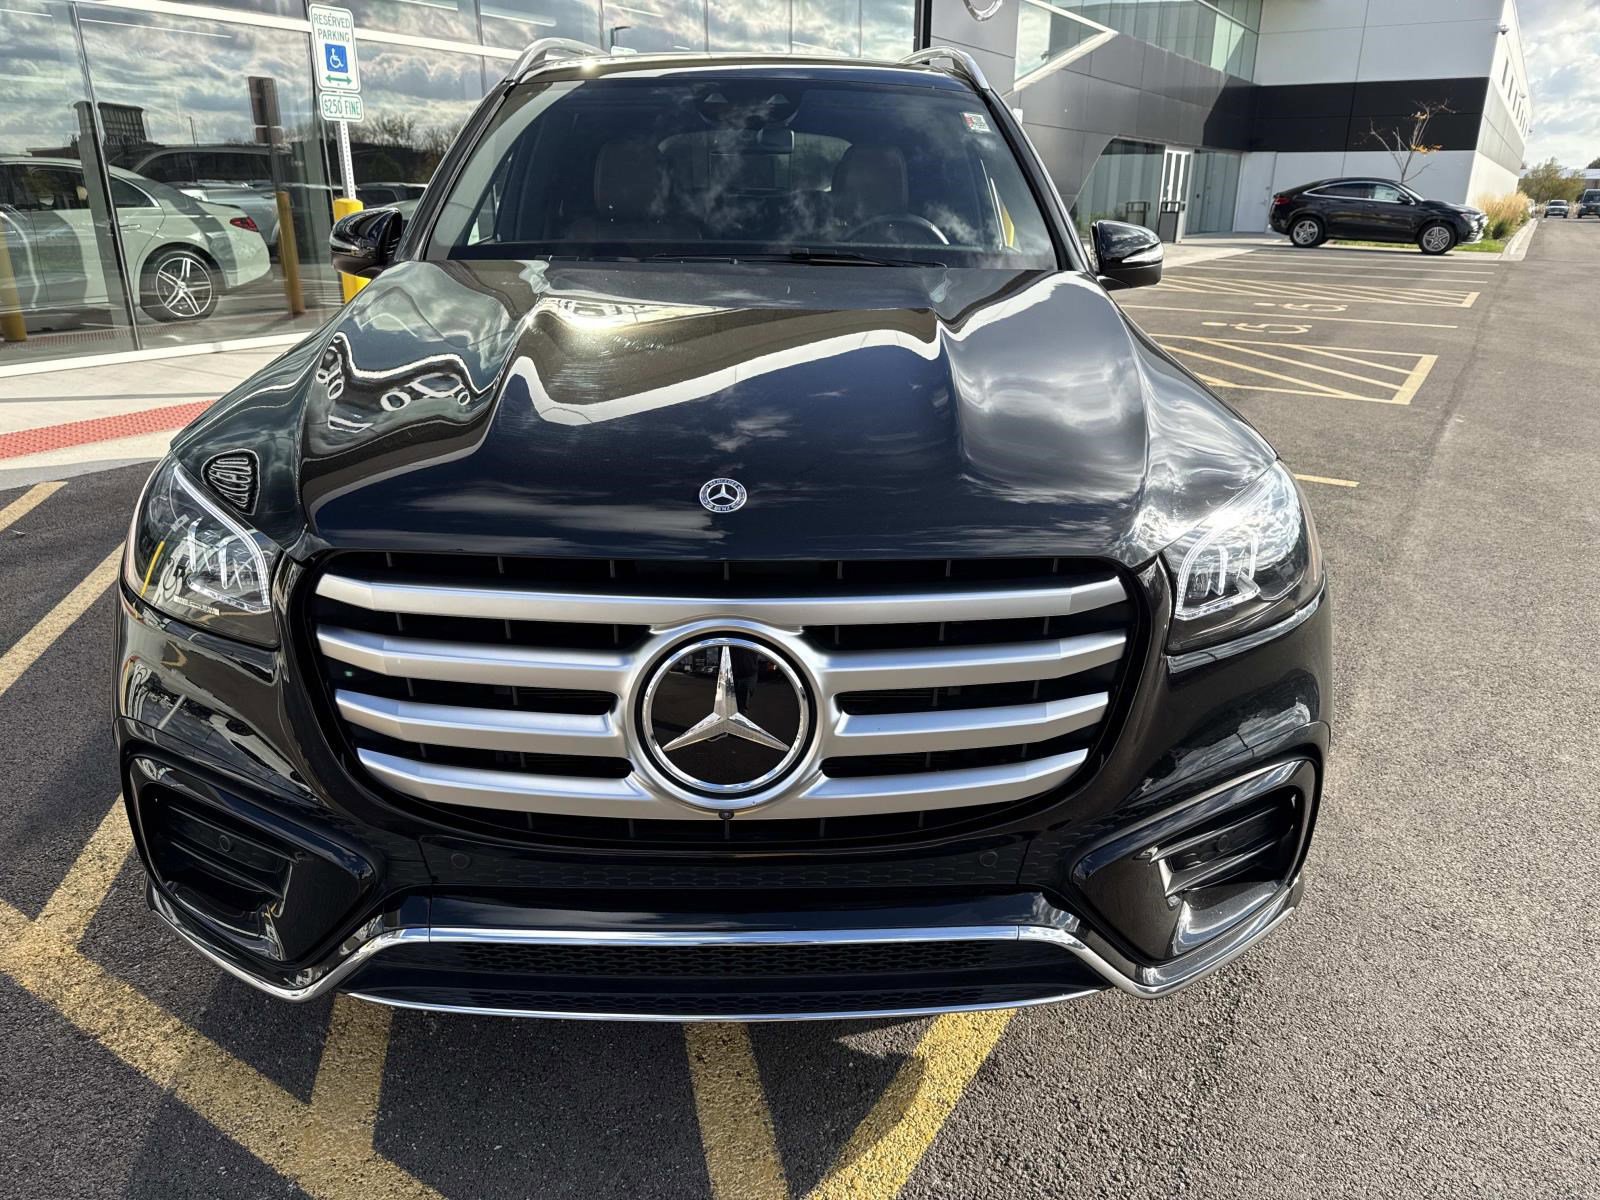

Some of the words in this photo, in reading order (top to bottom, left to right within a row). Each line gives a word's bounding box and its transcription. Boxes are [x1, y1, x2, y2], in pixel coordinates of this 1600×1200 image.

[313, 13, 350, 29] RESERVED
[317, 28, 350, 42] PARKING
[324, 98, 343, 114] $250
[344, 100, 361, 116] FINE
